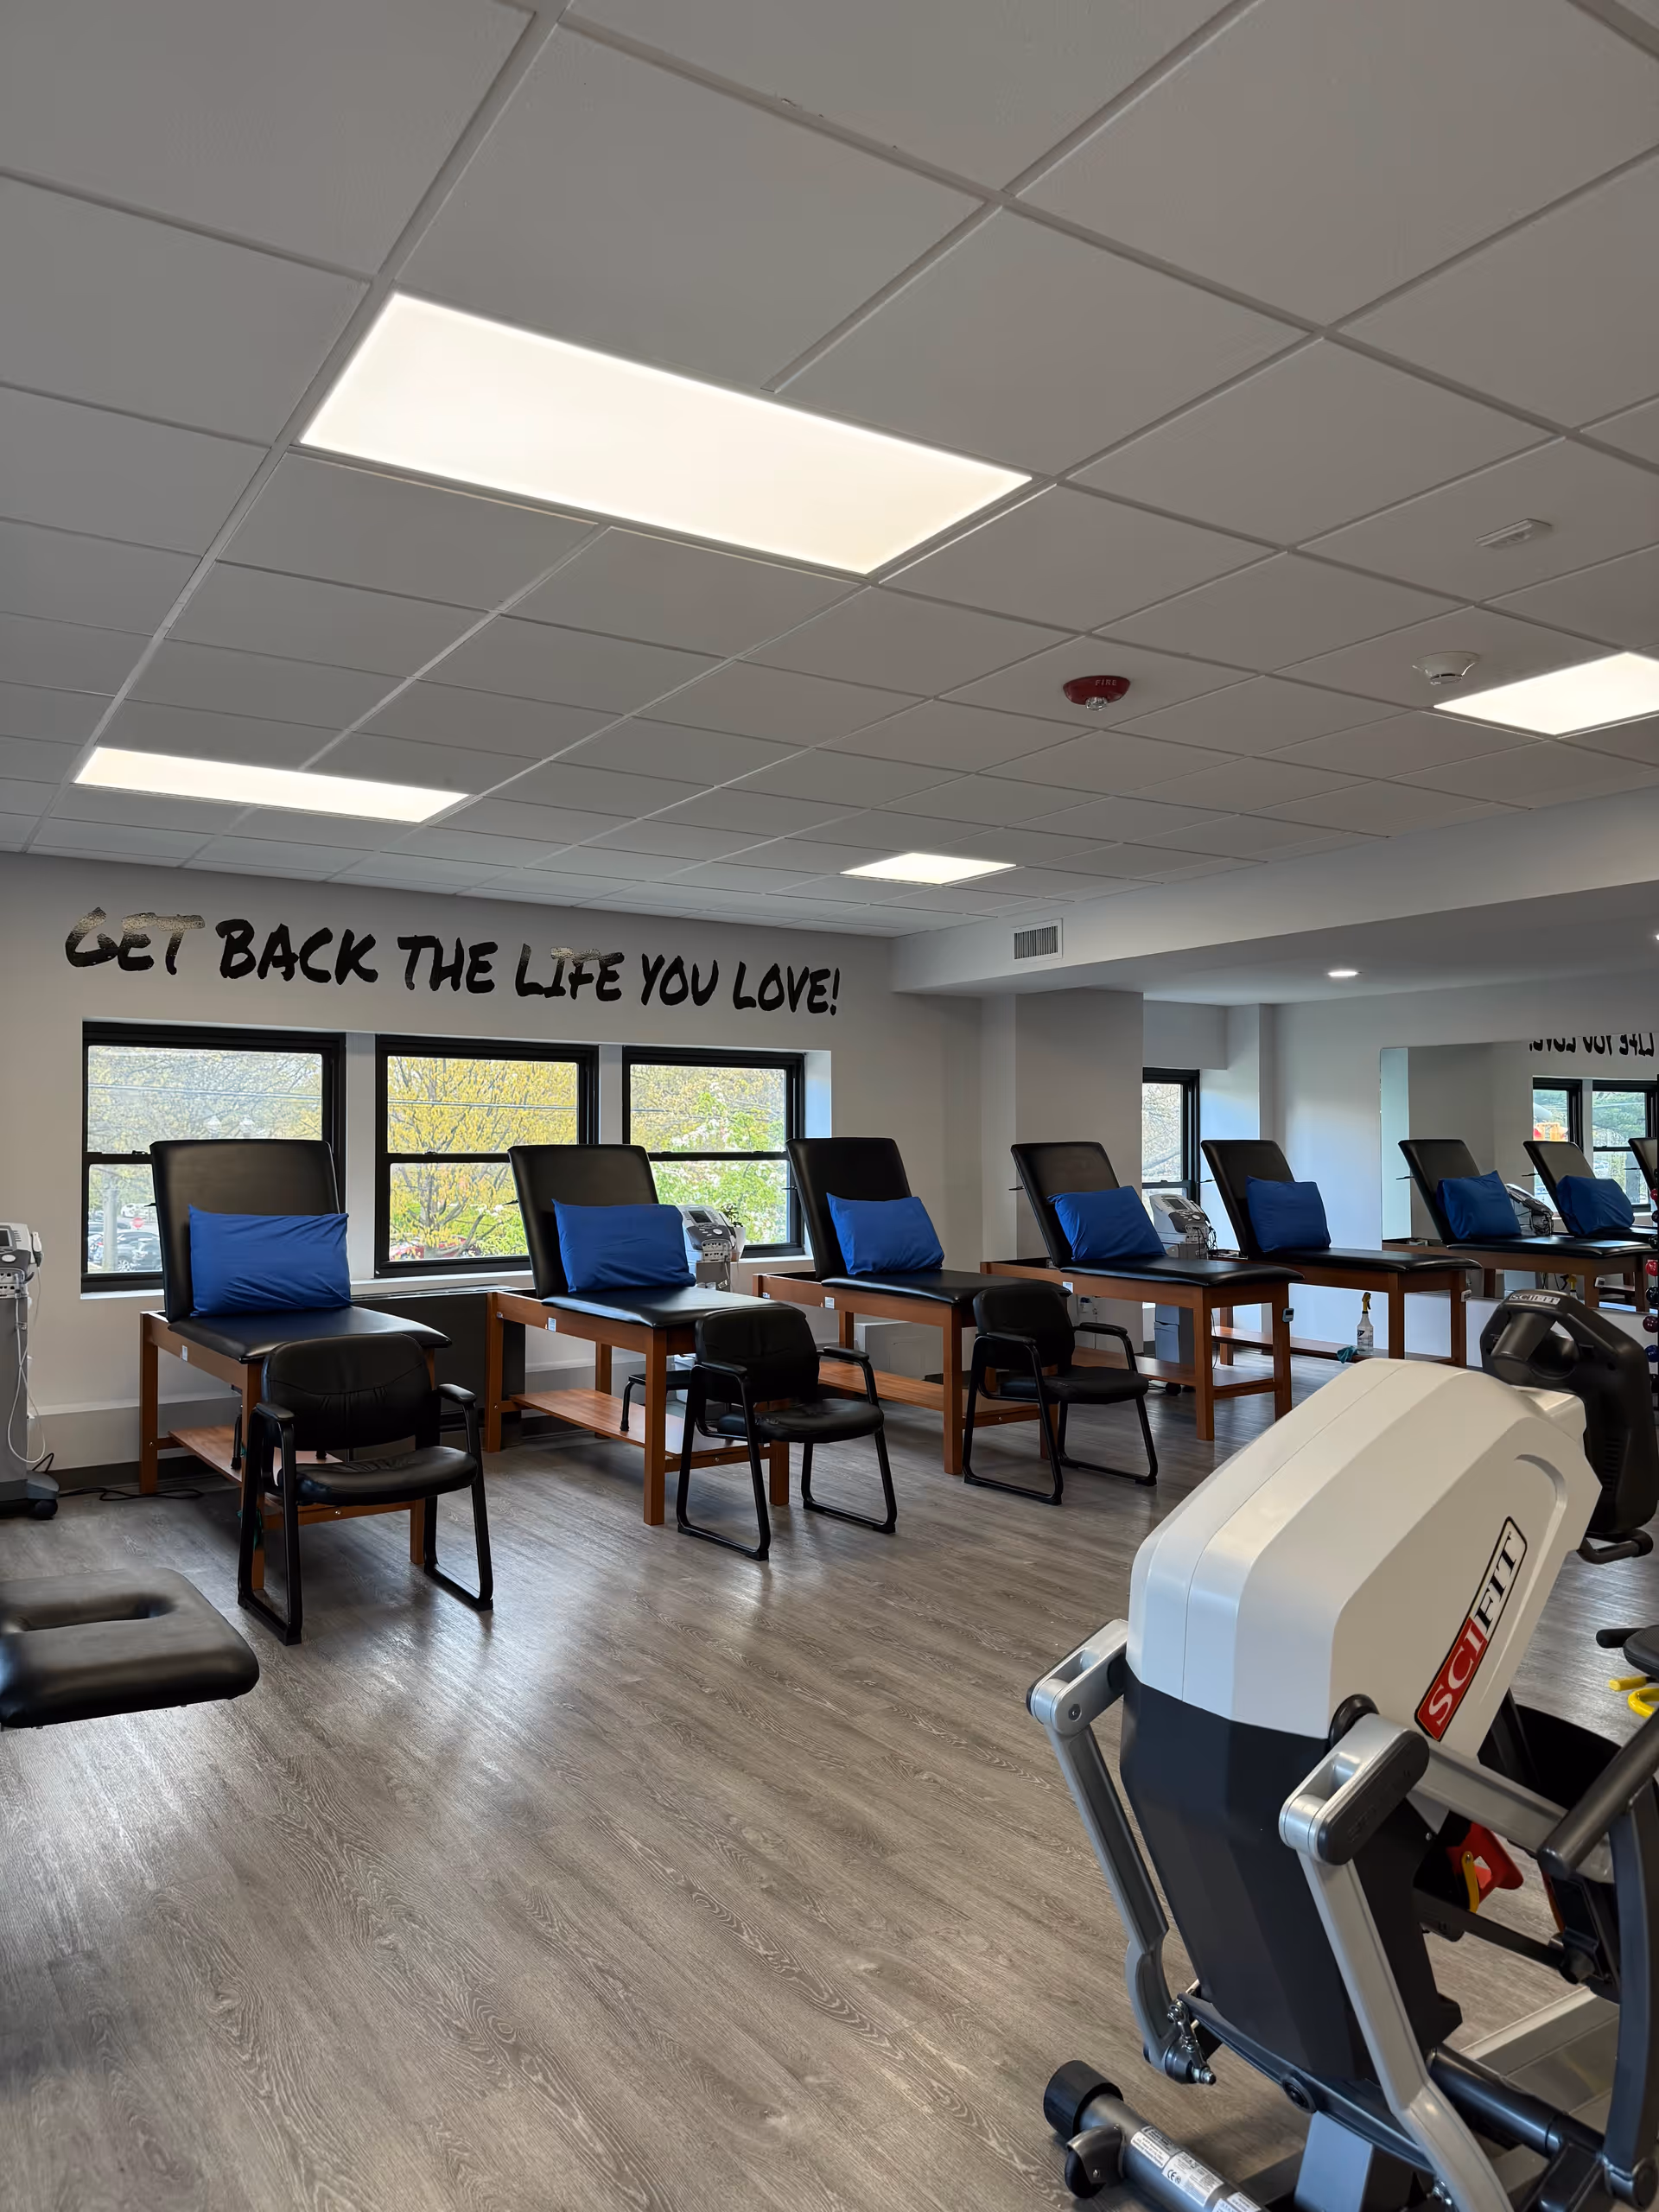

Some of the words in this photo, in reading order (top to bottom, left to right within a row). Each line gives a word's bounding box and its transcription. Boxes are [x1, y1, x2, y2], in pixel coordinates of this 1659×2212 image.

[65, 906, 206, 976] GET
[215, 918, 379, 985] BACK
[397, 934, 499, 995] THE
[515, 943, 625, 1001] LIFE
[640, 953, 719, 1007] YOU
[733, 961, 841, 1016] LOVE!
[1428, 1533, 1517, 1727] SCIFIT
